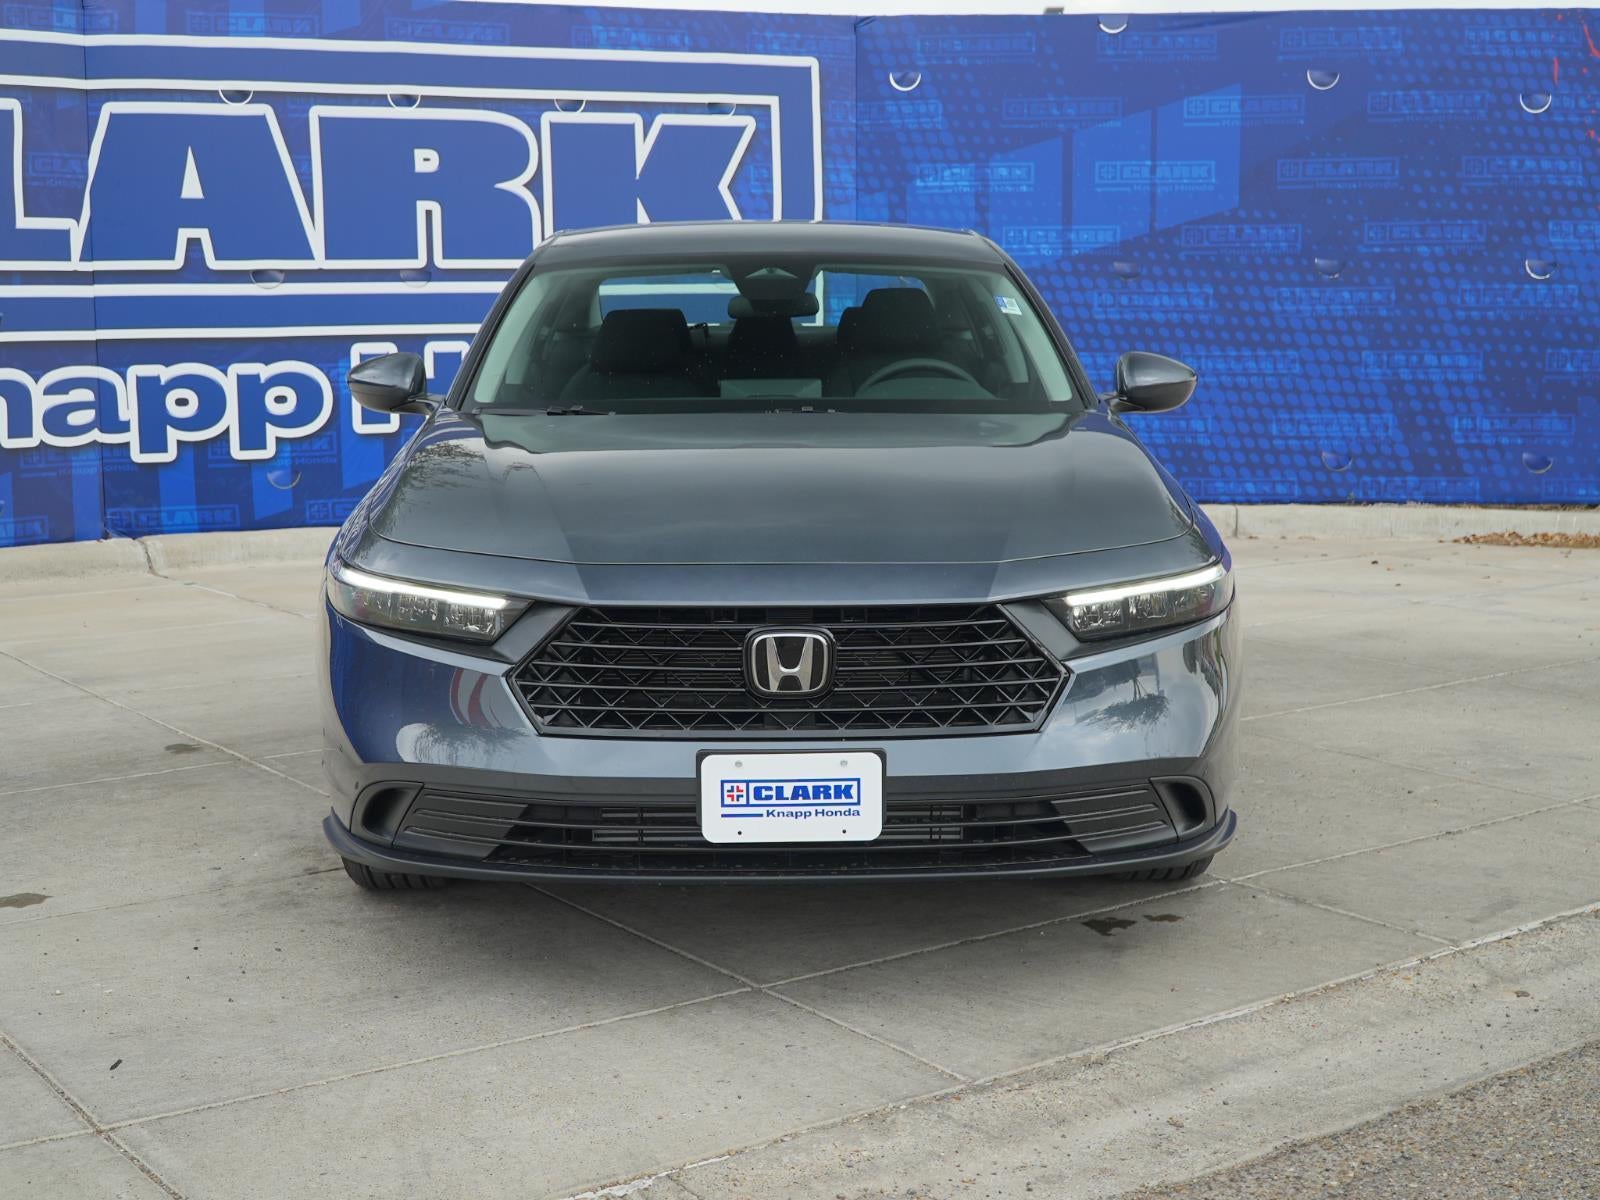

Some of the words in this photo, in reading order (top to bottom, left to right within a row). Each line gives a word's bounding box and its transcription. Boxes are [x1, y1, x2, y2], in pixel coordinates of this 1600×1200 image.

[753, 784, 854, 801] CLARK
[766, 809, 812, 819] Knapp
[815, 808, 861, 818] Honda
